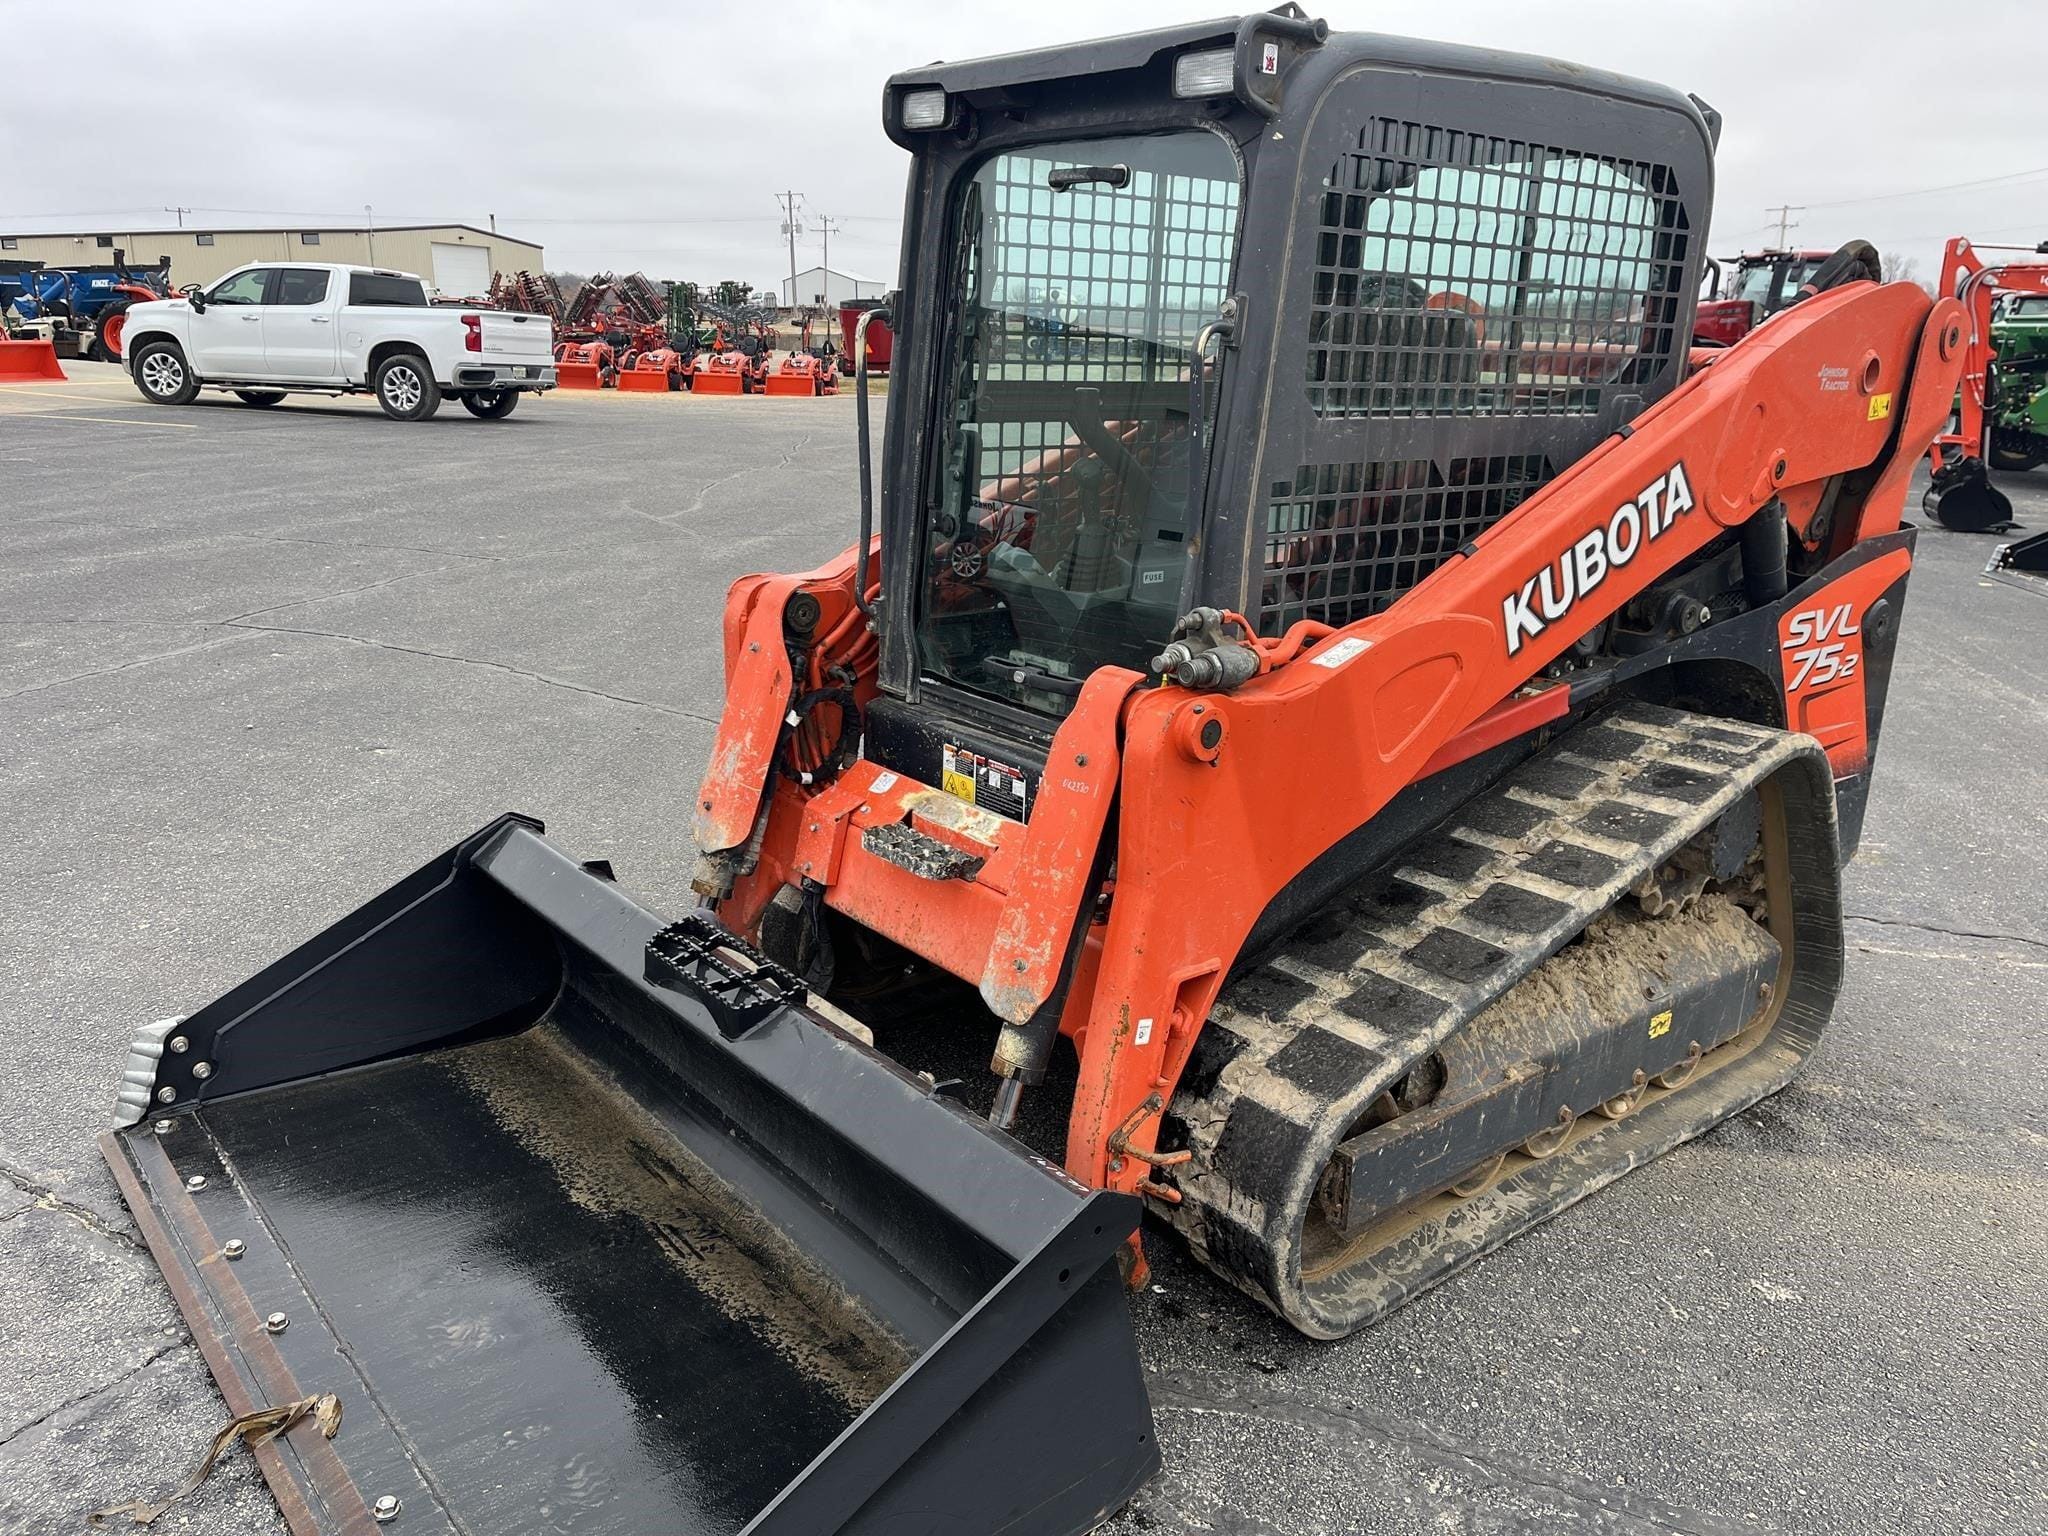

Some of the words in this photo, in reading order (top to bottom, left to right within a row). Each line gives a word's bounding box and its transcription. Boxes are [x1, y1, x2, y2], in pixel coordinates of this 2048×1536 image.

[1144, 573, 1163, 582] FUSE
[1502, 461, 1695, 657] KUBOTA
[1783, 603, 1859, 649] SVL
